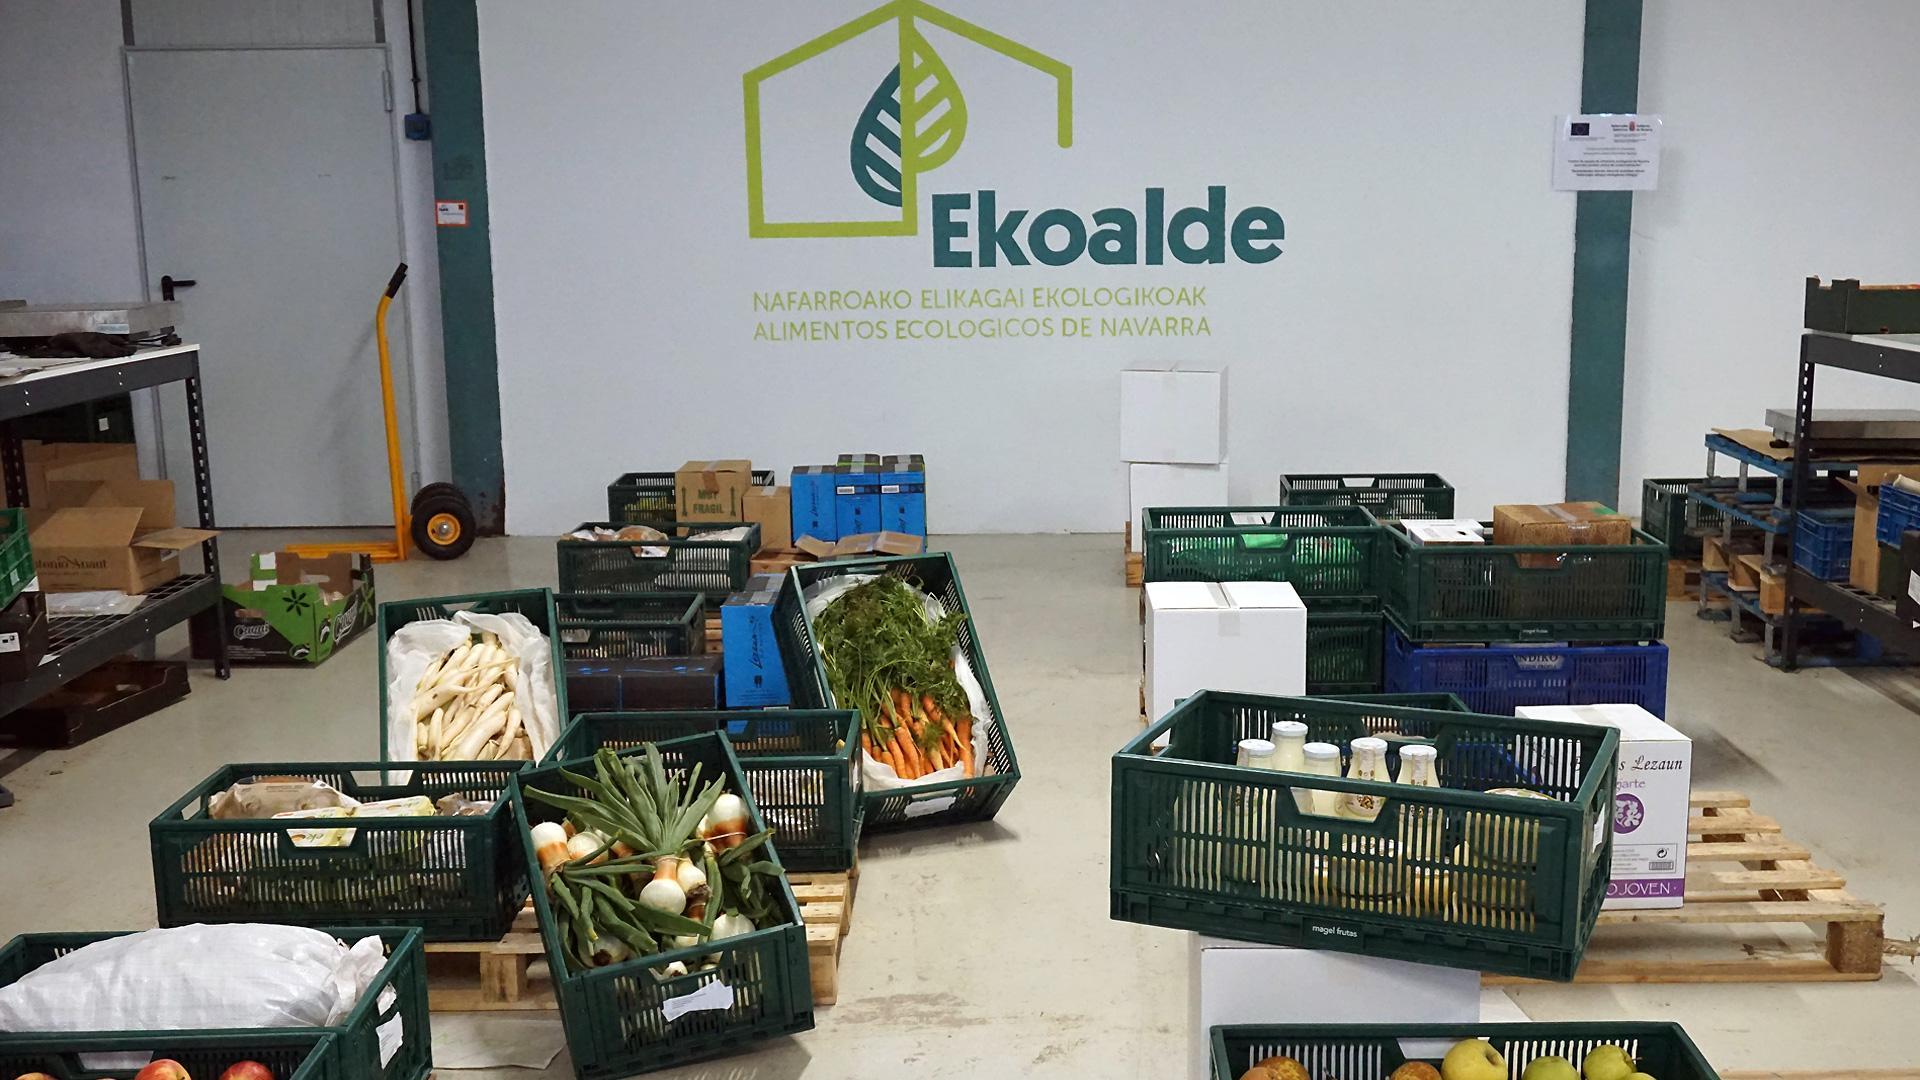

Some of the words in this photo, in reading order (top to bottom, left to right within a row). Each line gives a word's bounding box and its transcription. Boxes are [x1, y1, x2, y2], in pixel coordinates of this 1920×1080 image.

[931, 185, 1286, 268] Ekoalde
[753, 289, 912, 312] NAFARROAKO
[920, 288, 1025, 309] ELIKAGAI
[1032, 286, 1207, 308] EKOLOGIKOAK
[753, 319, 888, 341] ALIMENTOS
[895, 317, 1055, 340] ECOLOGICOS
[1062, 317, 1093, 338] DE
[1100, 316, 1212, 337] NAVARRA
[693, 503, 725, 514] FRAGIL
[1632, 755, 1683, 771] Lezaun
[1618, 882, 1671, 896] JOVEN
[1313, 926, 1336, 935] magel
[1336, 927, 1358, 937] frutas
